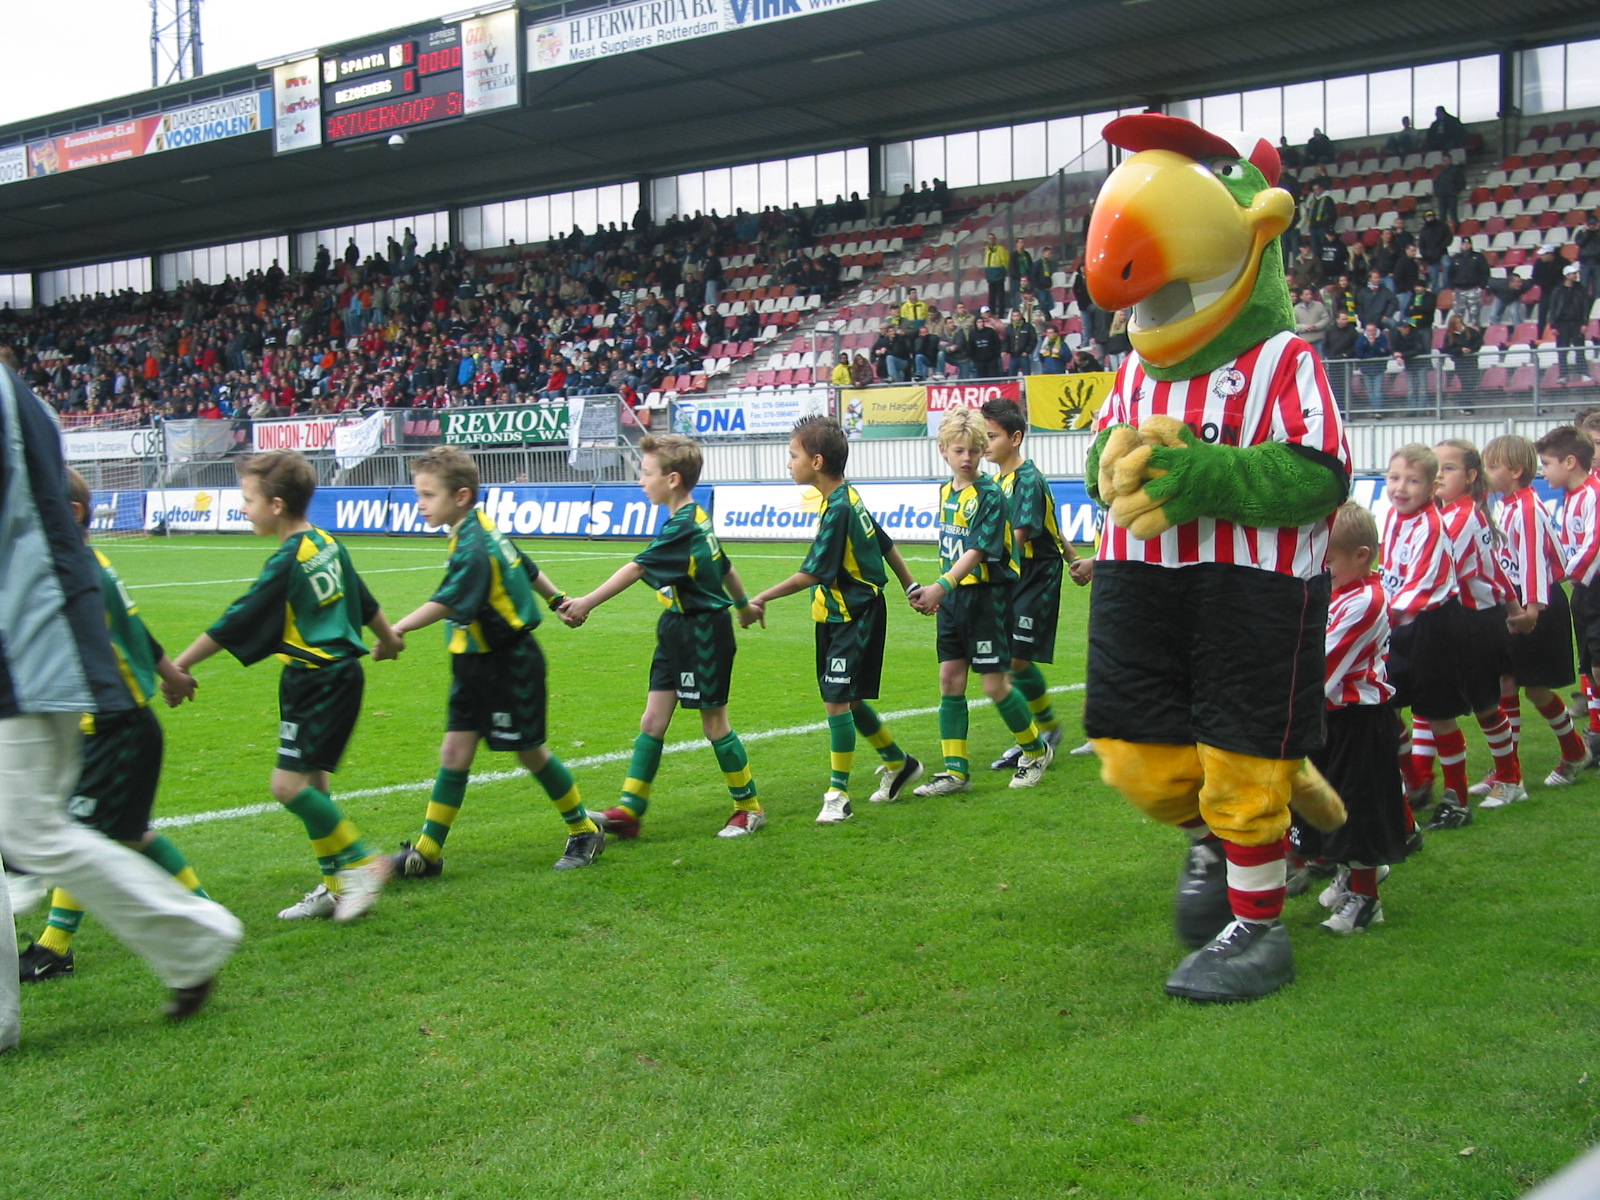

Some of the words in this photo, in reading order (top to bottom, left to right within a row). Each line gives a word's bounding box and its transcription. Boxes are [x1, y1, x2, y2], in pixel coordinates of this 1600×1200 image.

[569, 45, 596, 61] Meat
[600, 34, 652, 54] Suppliers
[657, 19, 719, 42] Rotterdam
[341, 53, 385, 74] SPARTA
[446, 91, 463, 116] S
[871, 402, 887, 411] The
[889, 402, 919, 412] Hague
[930, 387, 1001, 409] MARIO
[696, 408, 746, 432] DNA
[446, 432, 522, 445] PLAFONDS
[152, 505, 211, 523] sudtours
[336, 488, 660, 535] www.tours.nl
[724, 503, 820, 528] sudtour
